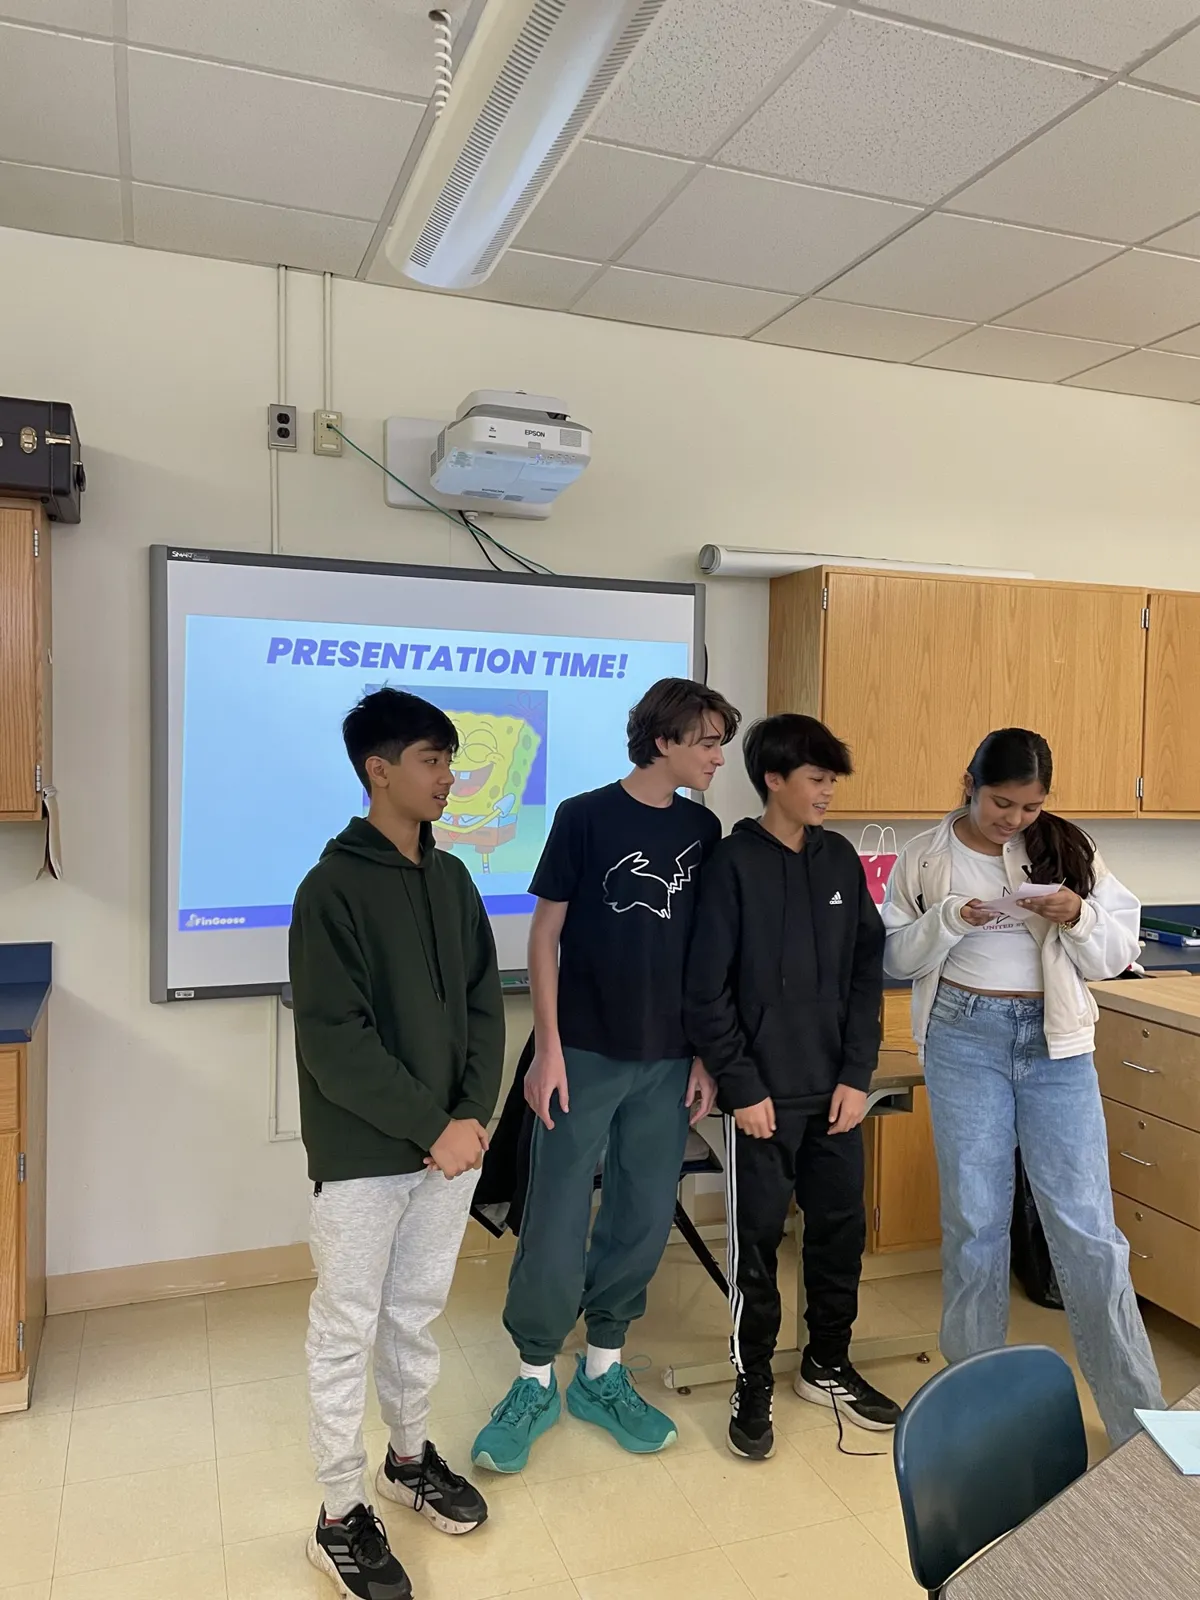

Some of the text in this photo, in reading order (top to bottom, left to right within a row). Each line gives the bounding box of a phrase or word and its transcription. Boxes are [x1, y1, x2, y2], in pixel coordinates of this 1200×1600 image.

[524, 430, 546, 438] EPSON
[266, 637, 629, 679] PRESENTATION TIME!
[195, 916, 246, 926] FinGoose
